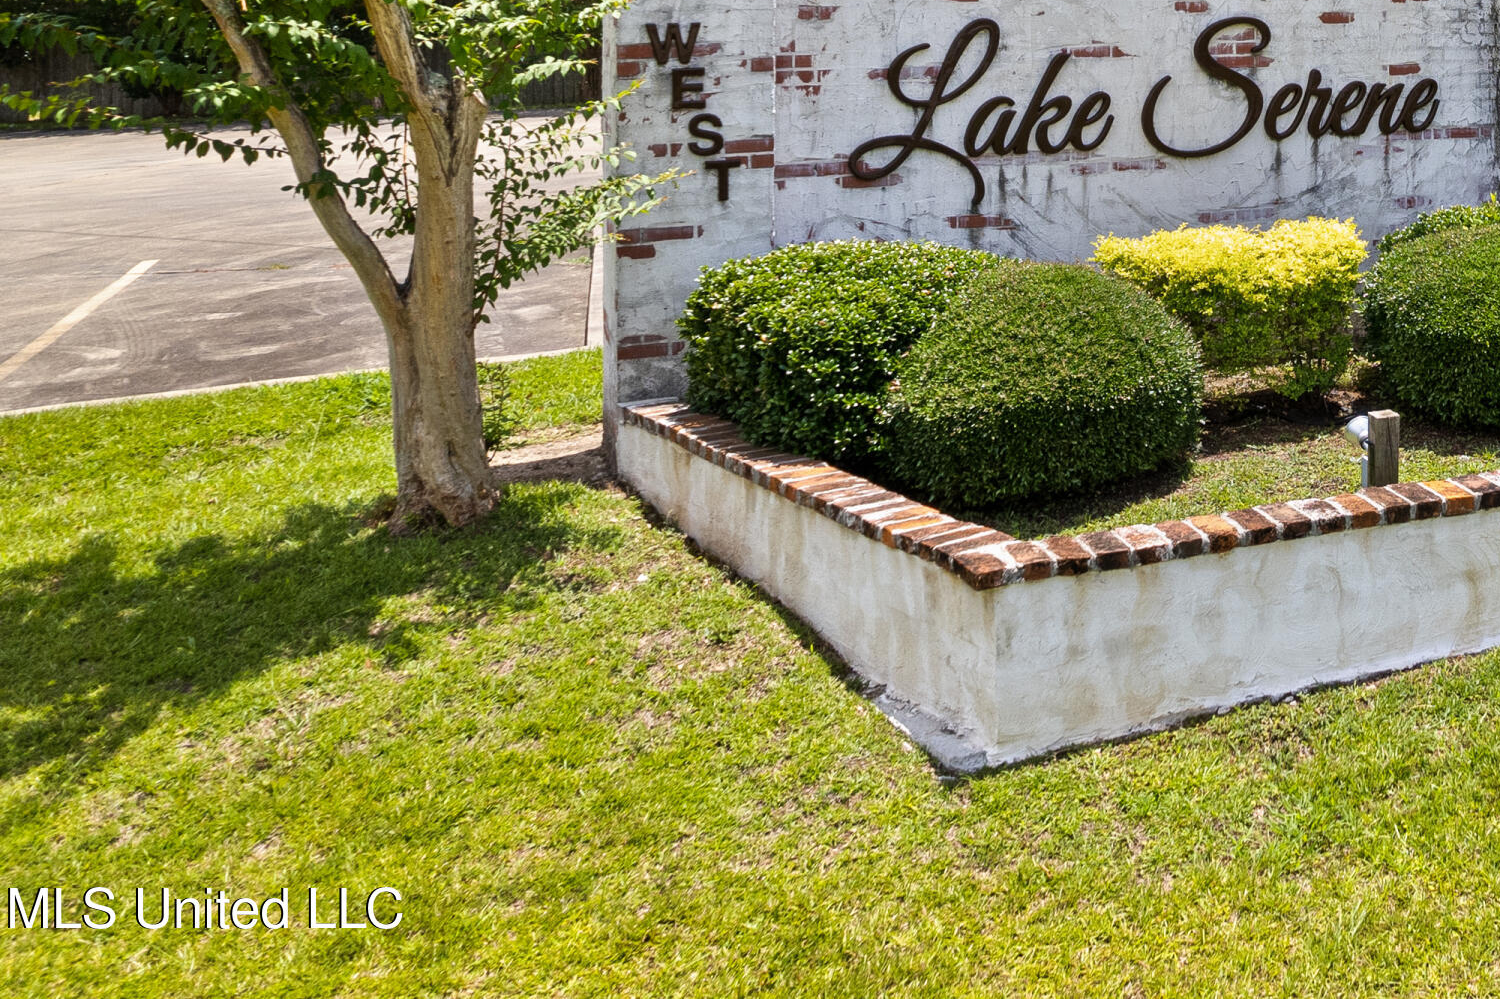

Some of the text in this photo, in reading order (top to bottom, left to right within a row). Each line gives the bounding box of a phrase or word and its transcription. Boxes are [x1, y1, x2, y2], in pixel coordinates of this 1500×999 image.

[645, 22, 741, 202] WEST
[848, 16, 1440, 203] Lake Serene
